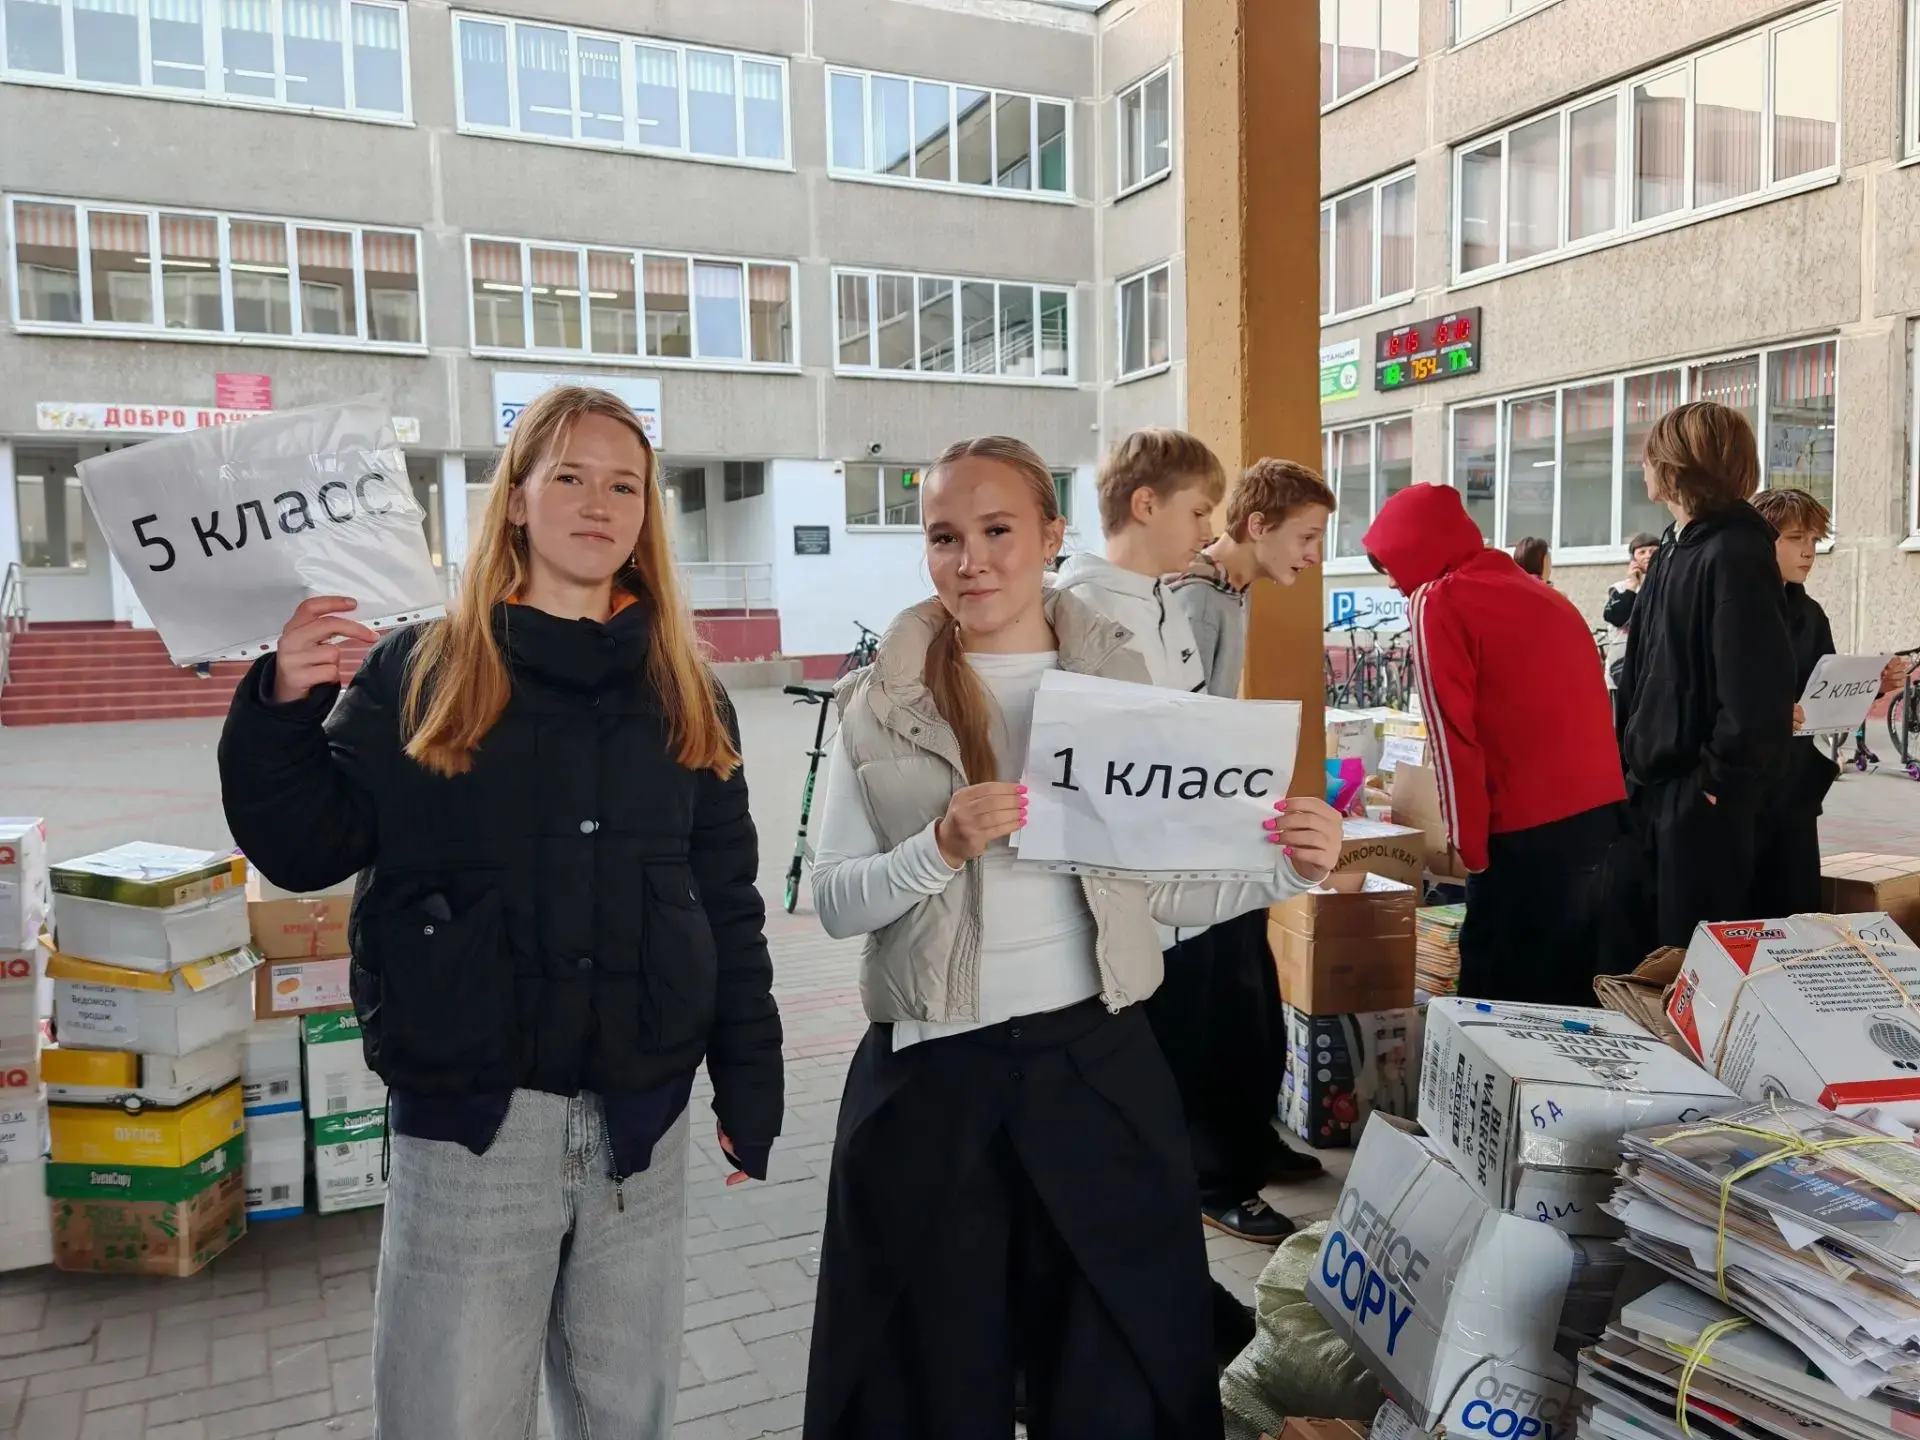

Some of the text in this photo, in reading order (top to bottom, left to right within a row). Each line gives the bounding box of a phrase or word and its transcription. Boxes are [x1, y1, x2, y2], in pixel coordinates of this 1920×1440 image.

[1411, 358, 1437, 379] 754
[104, 407, 185, 428] ДОБРО
[132, 471, 392, 572] 5 класс
[1810, 679, 1878, 699] 2 класс
[1050, 747, 1274, 800] 1 класс
[1391, 847, 1418, 868] KRAY
[1505, 1029, 1653, 1052] WARRIOR
[1553, 1044, 1631, 1060] BLUE
[114, 1127, 163, 1143] OFFICE
[1477, 1073, 1496, 1187] WARRIOR
[1487, 1105, 1502, 1173] BLUE
[91, 1171, 132, 1188] SvetoCopy
[1338, 1187, 1430, 1306] OFFICE
[1322, 1231, 1413, 1356] COPY
